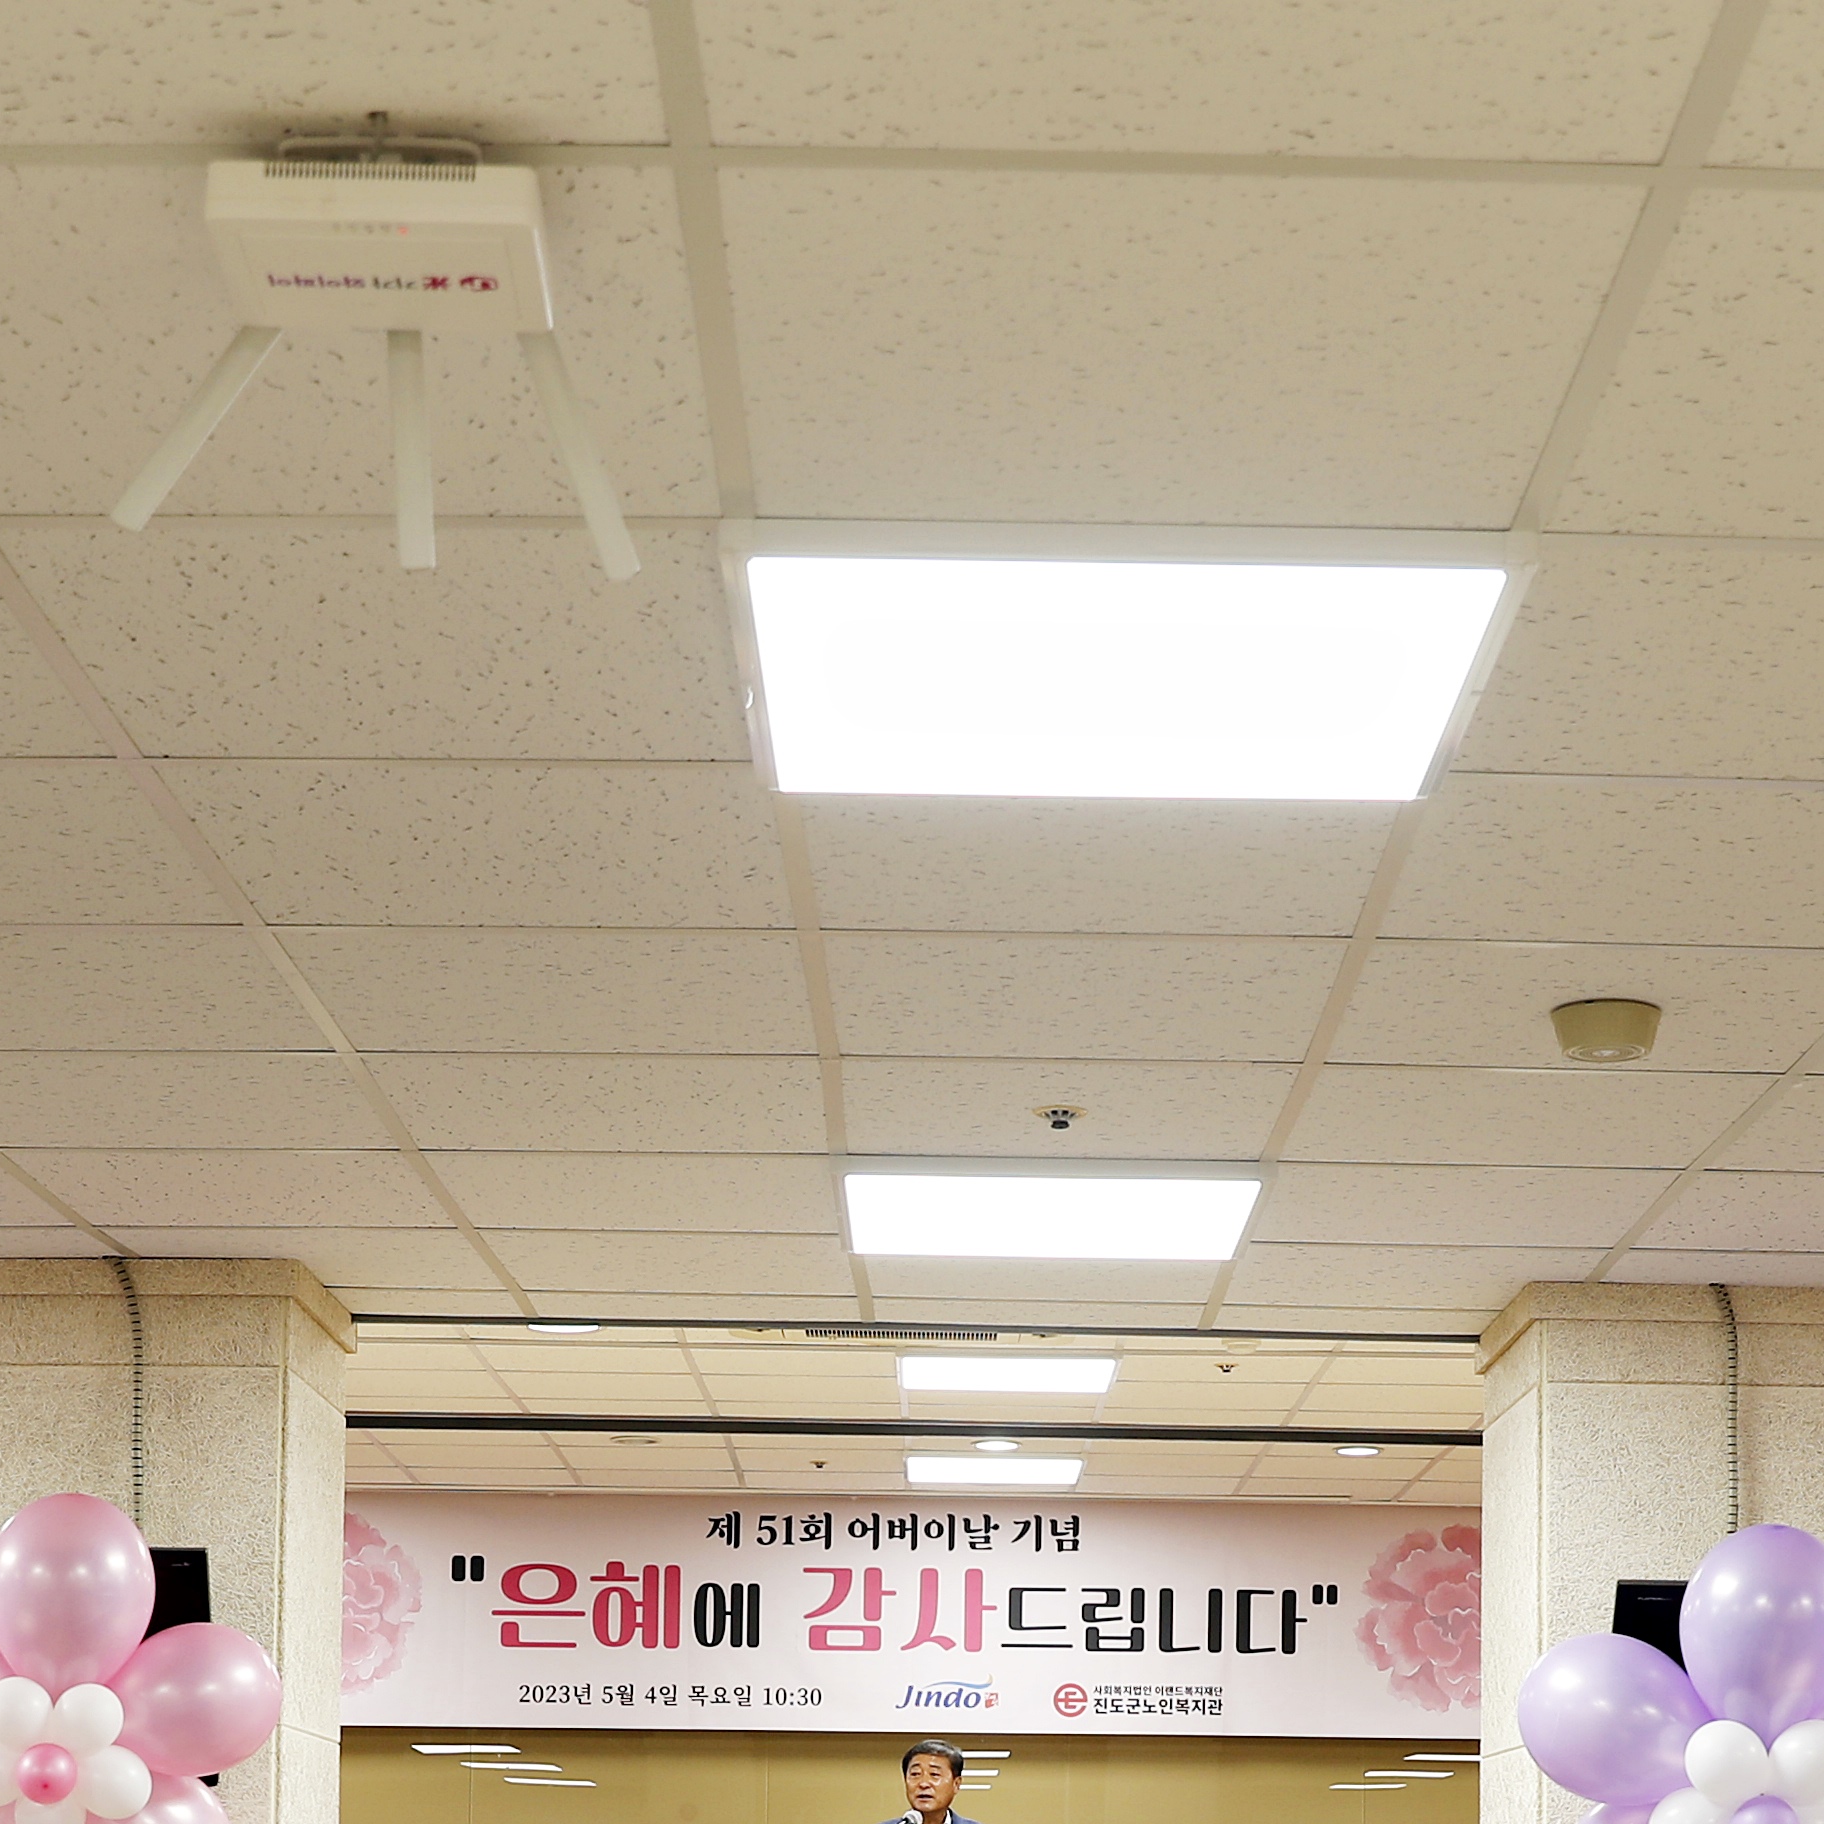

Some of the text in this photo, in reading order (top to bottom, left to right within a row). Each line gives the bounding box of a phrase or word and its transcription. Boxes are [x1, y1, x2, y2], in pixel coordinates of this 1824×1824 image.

[705, 1511, 1080, 1552] 제 51회 어버이날 기념
[519, 1683, 823, 1707] 2023년 5월 4일 목요일 10:30
[895, 1685, 982, 1709] Jindo
[1093, 1685, 1223, 1697] 사회복지법인 이랜드복지재단
[1093, 1698, 1223, 1716] 진도군노인복지관
